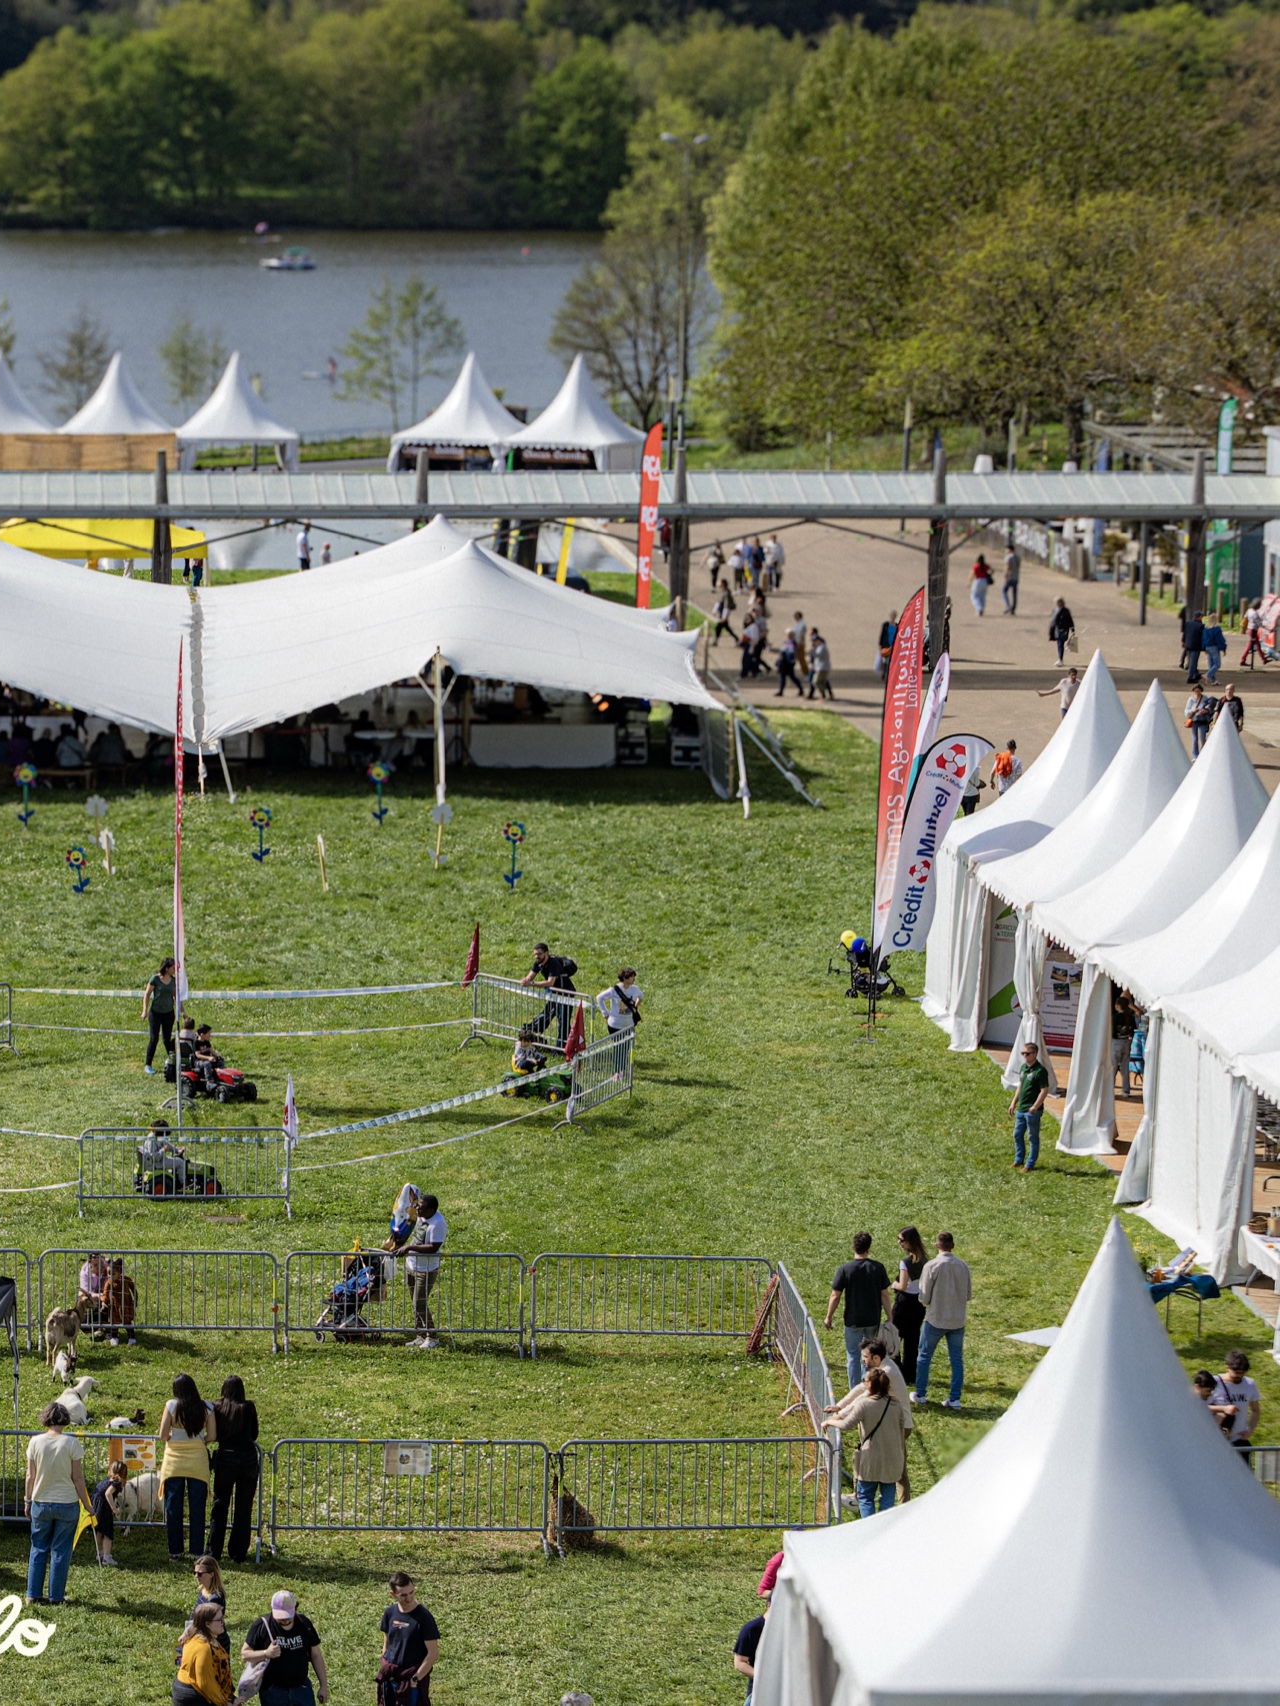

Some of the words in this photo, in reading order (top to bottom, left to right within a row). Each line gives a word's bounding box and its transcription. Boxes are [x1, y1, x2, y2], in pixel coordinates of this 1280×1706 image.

[925, 770, 943, 779] Crédit
[892, 884, 925, 948] Crédit
[917, 787, 951, 859] Mutuel
